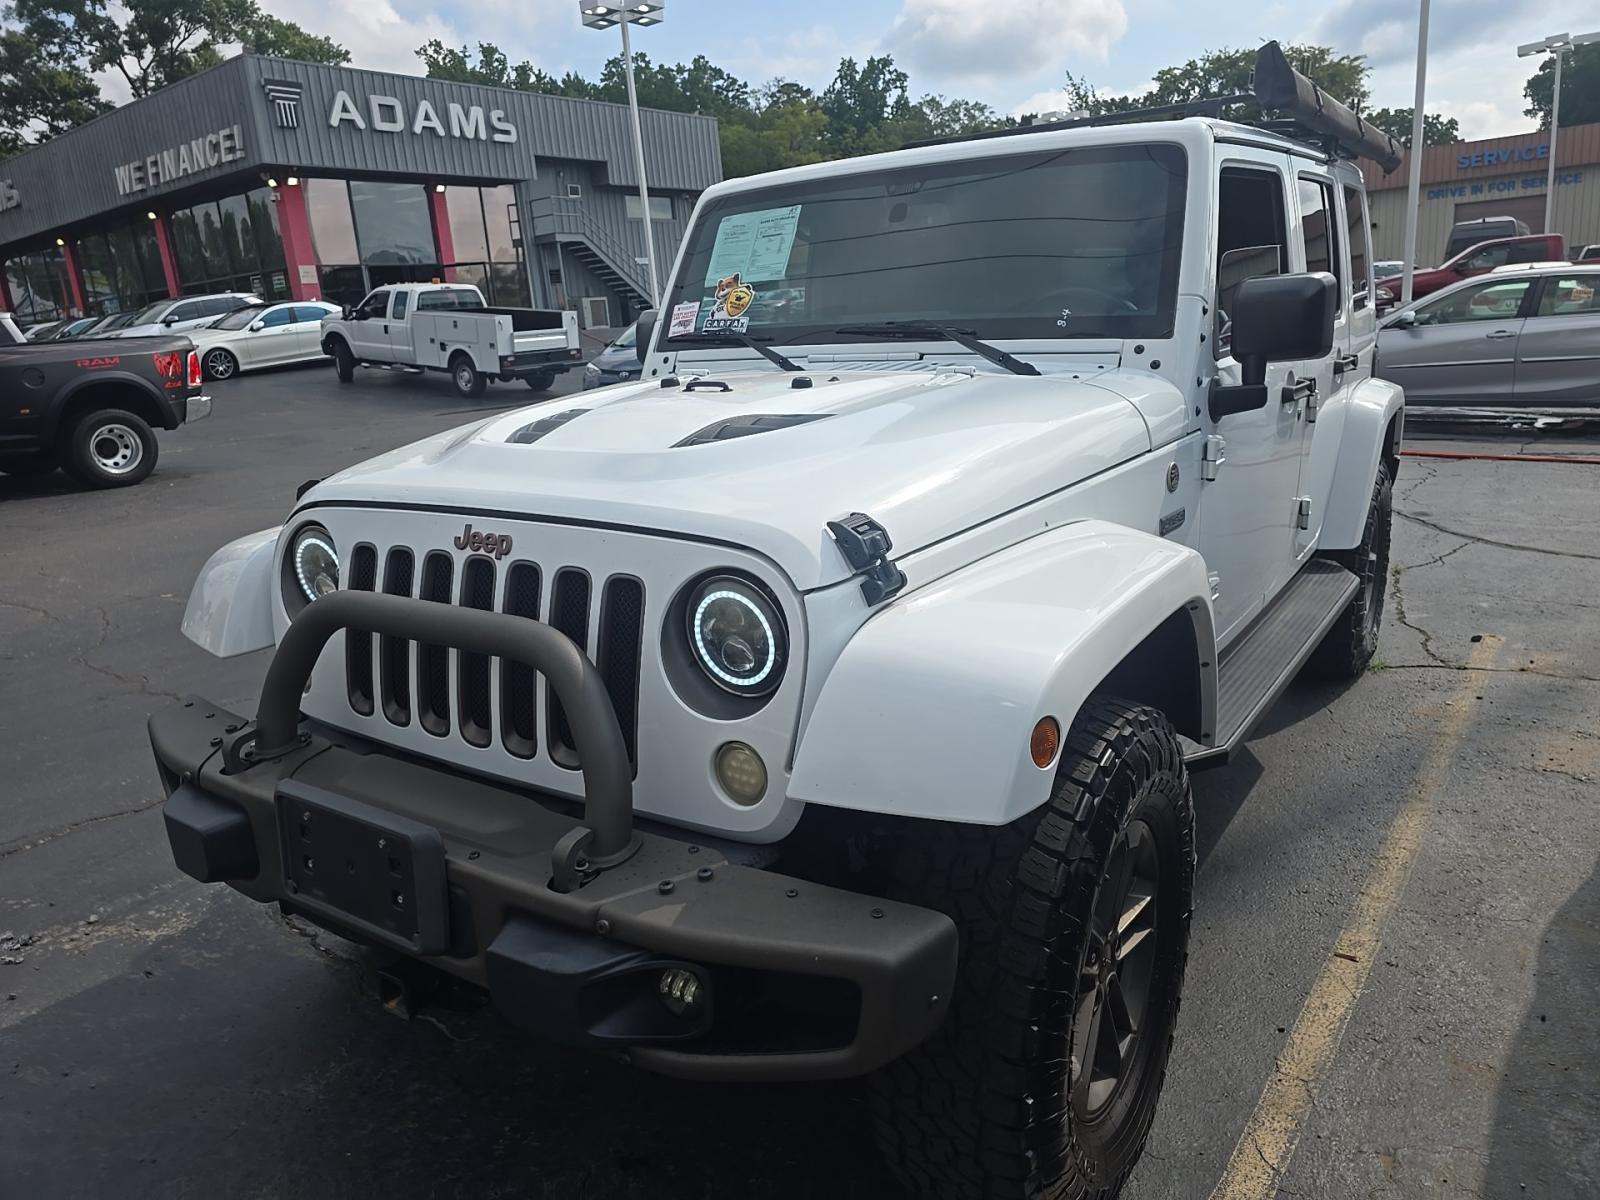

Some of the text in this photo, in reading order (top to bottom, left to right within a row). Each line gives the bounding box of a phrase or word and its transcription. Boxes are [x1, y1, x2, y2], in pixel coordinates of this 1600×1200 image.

[329, 90, 518, 144] ADAMS
[115, 124, 245, 195] WE FINANCE!
[1456, 144, 1549, 169] SERVICE
[1427, 172, 1583, 200] DRIVE IN FOR SERICE
[705, 318, 747, 329] CARFAX
[75, 356, 120, 367] RAM
[453, 523, 513, 561] Jeep
